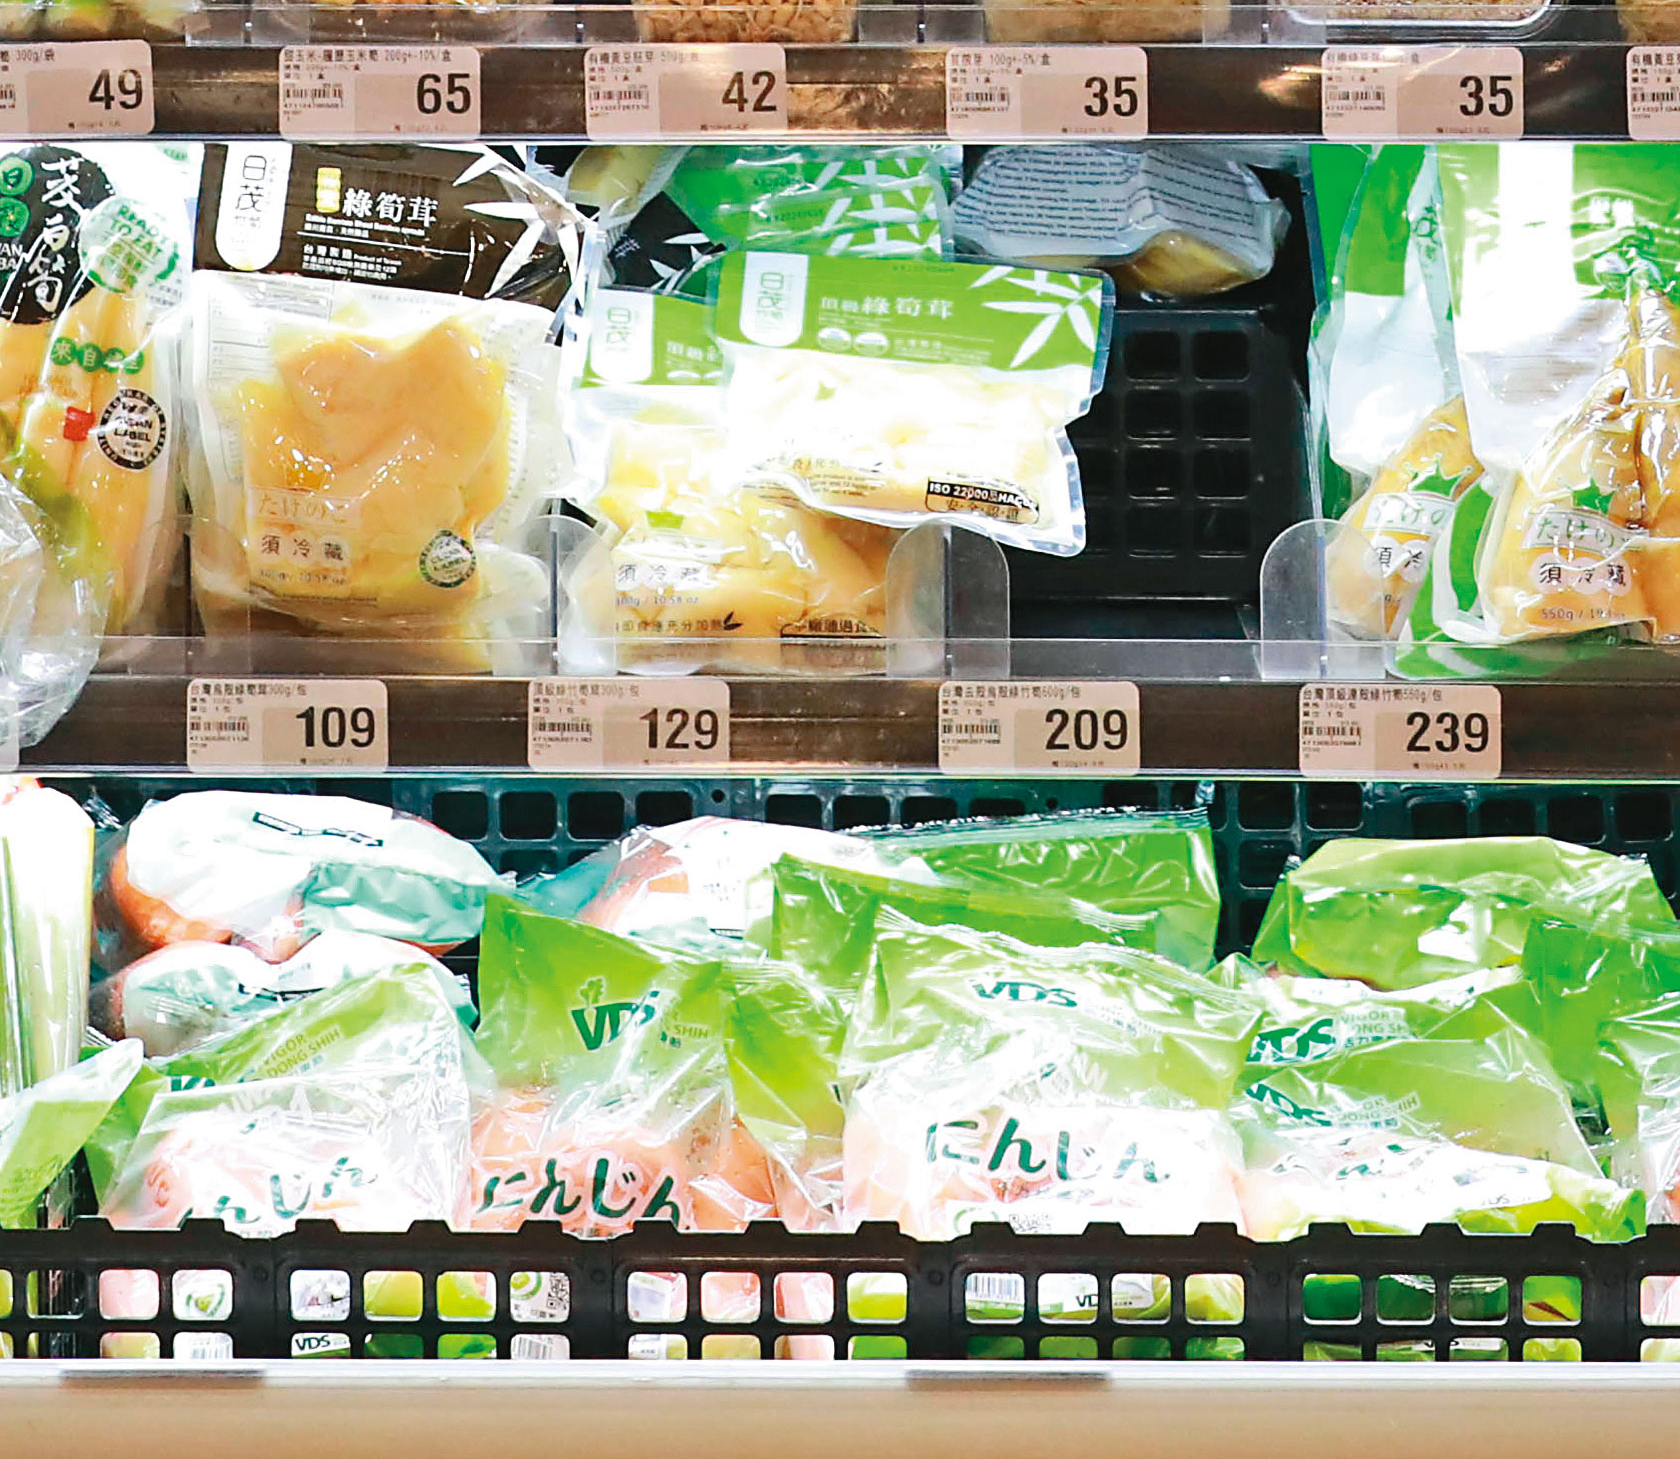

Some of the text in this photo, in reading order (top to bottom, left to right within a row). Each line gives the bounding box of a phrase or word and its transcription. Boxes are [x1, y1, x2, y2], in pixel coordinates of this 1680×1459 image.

[89, 69, 142, 109] 49
[417, 74, 470, 114] 65
[723, 71, 776, 112] 42
[1085, 77, 1137, 116] 35
[1460, 76, 1513, 116] 35
[234, 155, 267, 213] 日茂
[342, 187, 439, 224] 綠筍茸
[930, 482, 950, 495] ISO
[260, 533, 343, 562] 須冷藏
[296, 707, 374, 747] 109
[641, 708, 718, 749] 129
[1046, 709, 1127, 750] 209
[1407, 712, 1488, 752] 239
[266, 1028, 342, 1079] DONG SHIH
